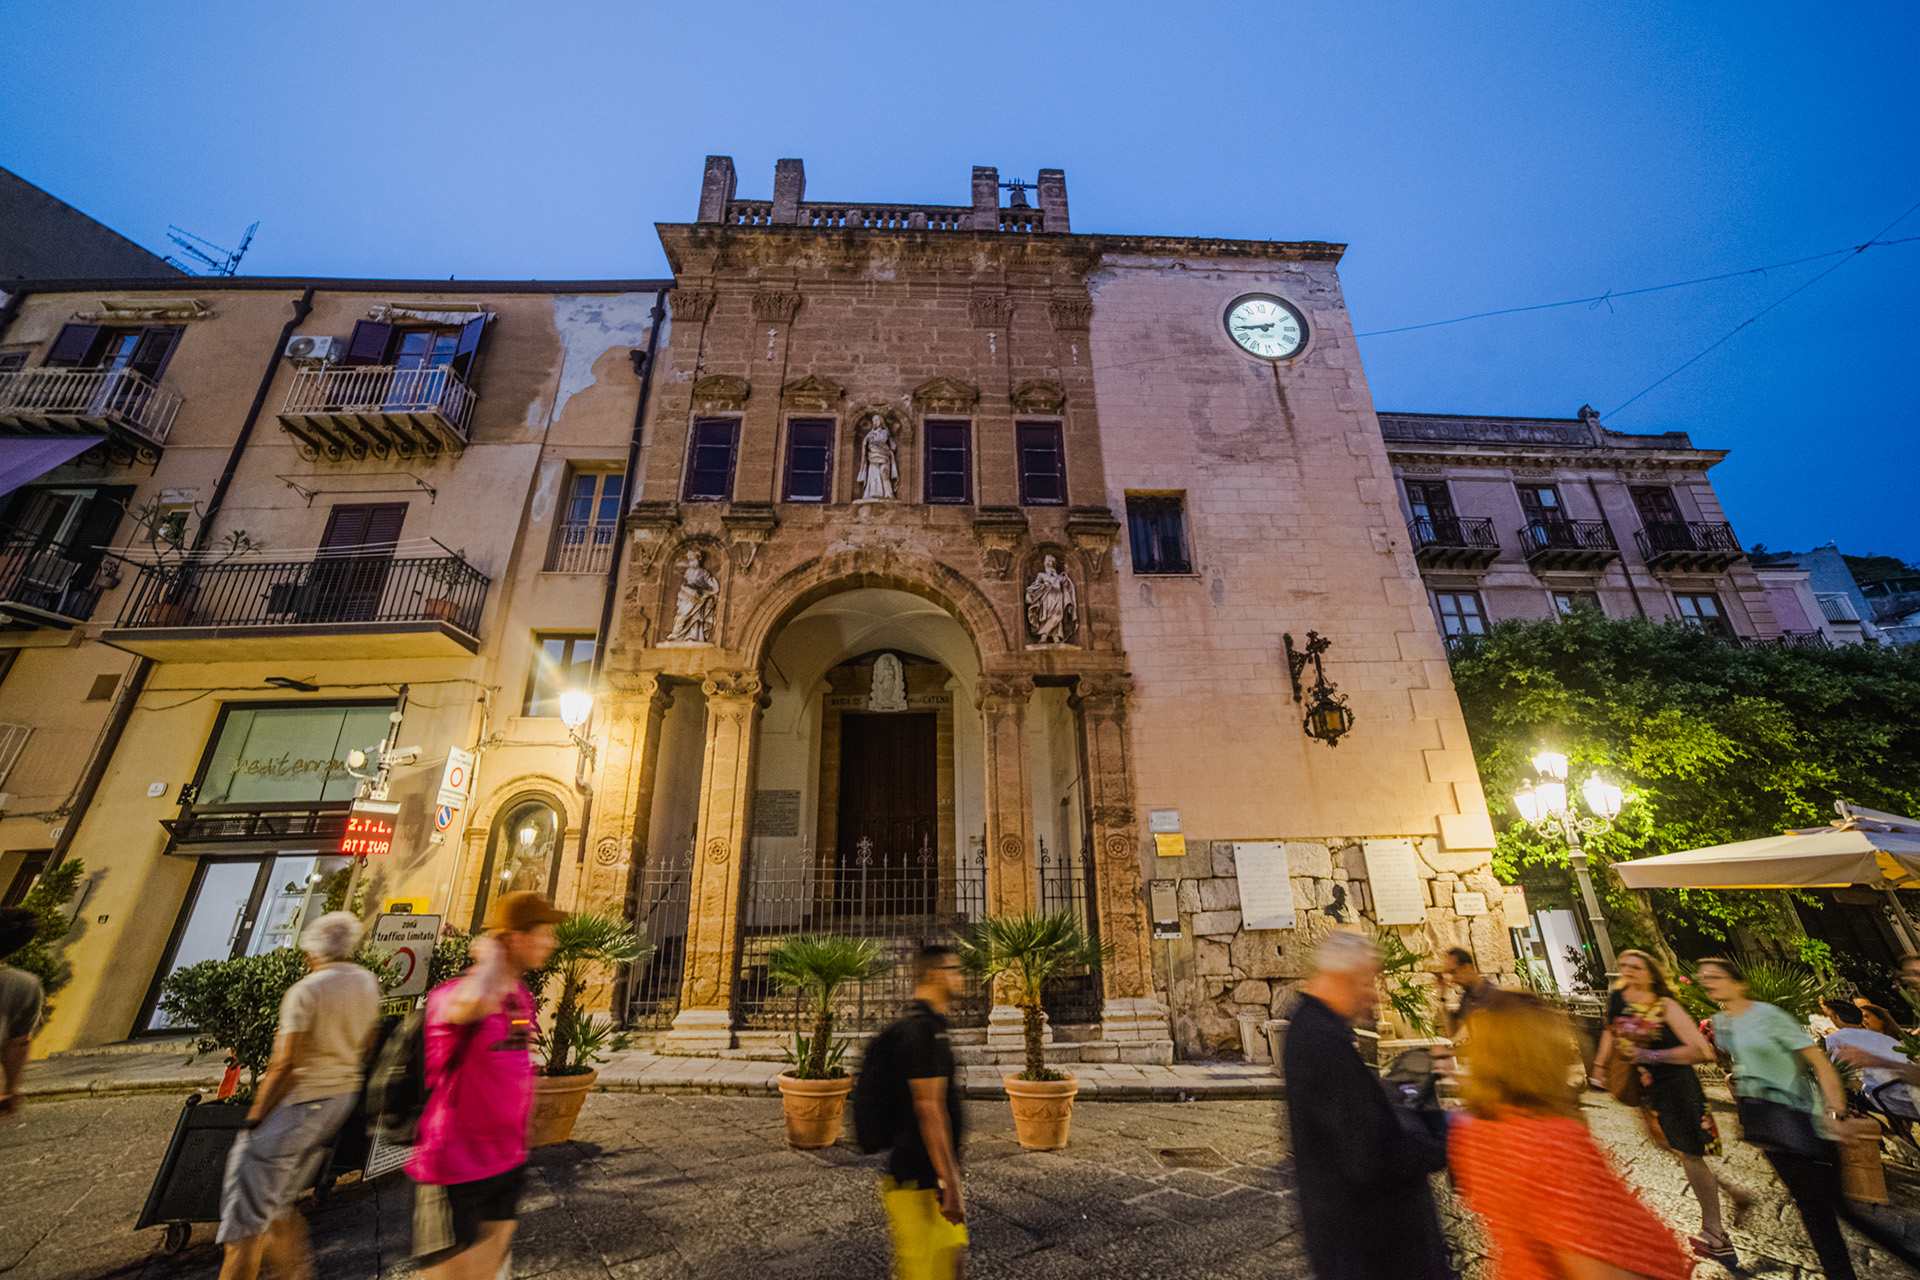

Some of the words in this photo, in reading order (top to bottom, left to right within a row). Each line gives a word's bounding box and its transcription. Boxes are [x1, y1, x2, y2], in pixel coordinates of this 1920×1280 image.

[347, 818, 392, 834] Z.T.L.
[341, 839, 390, 854] ATTIVA
[402, 921, 417, 929] zona
[377, 931, 405, 941] traffico
[407, 931, 434, 941] limitato
